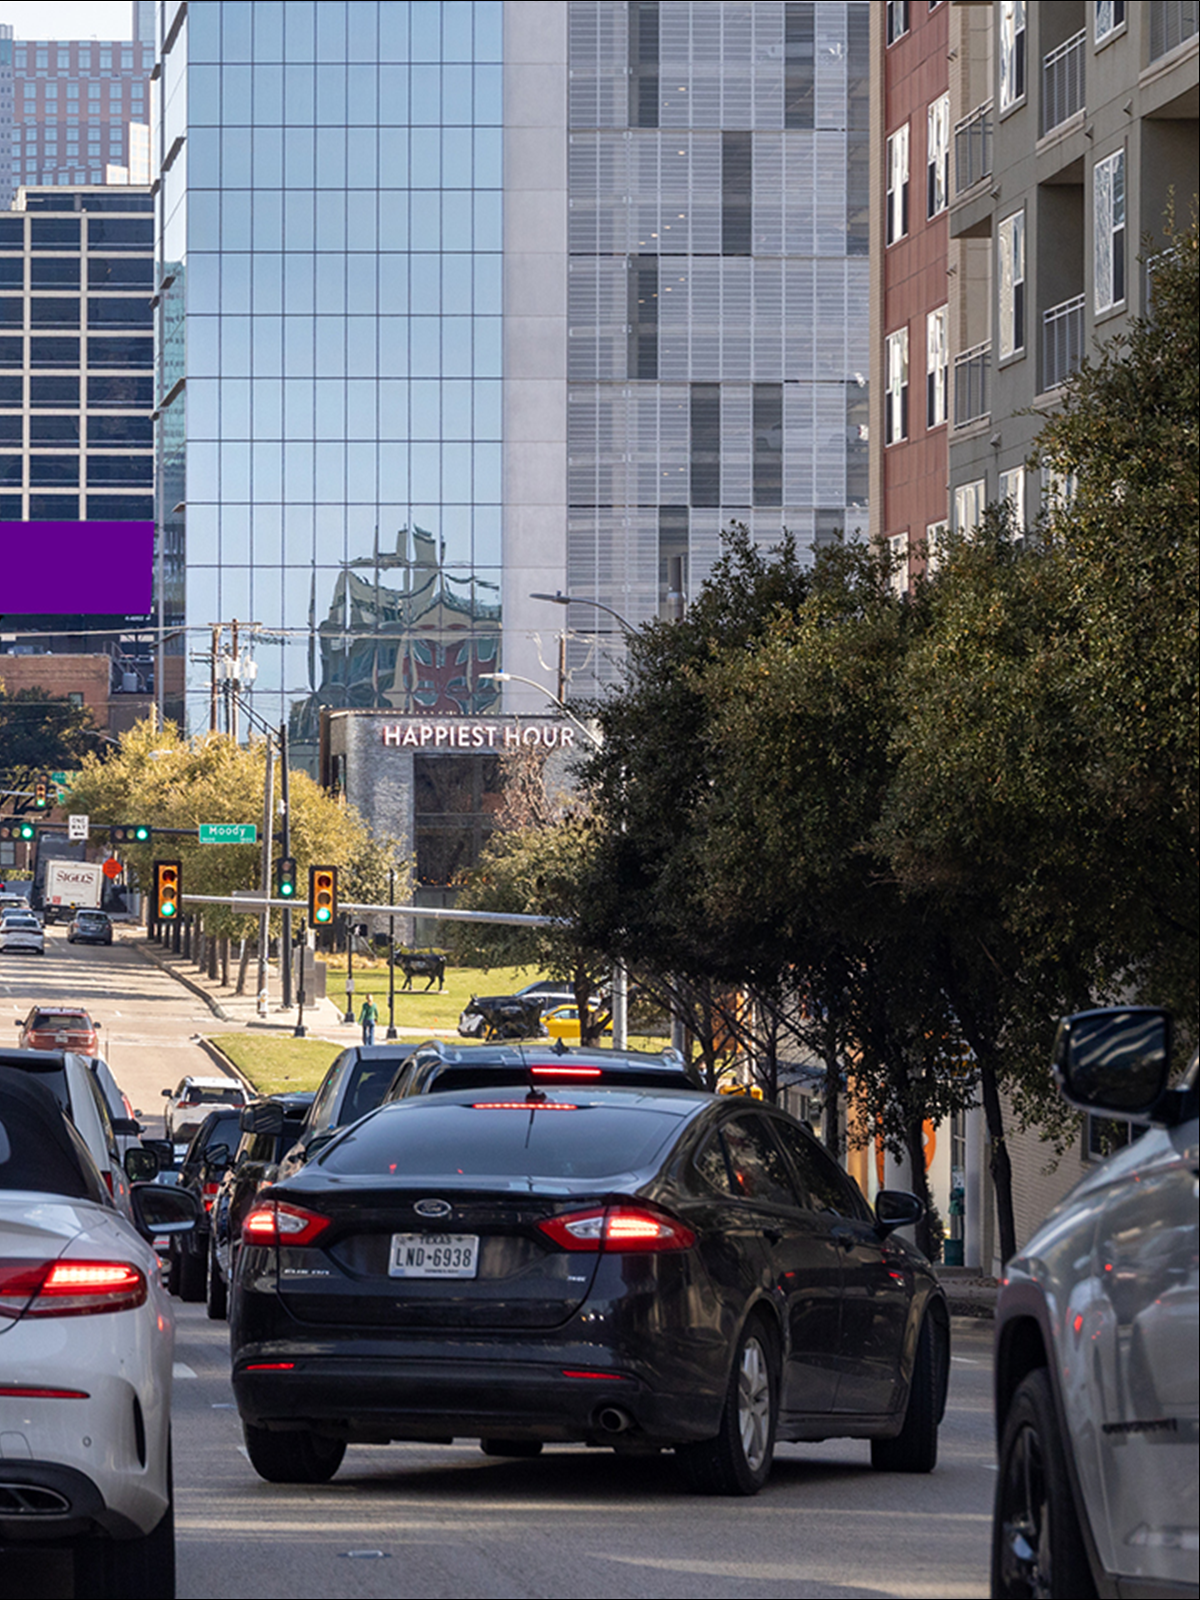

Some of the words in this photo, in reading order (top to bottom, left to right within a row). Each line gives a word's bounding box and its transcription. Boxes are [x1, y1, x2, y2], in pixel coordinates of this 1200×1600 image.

[383, 725, 497, 747] HAPPIEST
[505, 726, 575, 747] HOUR
[209, 825, 246, 838] Moody
[420, 1234, 452, 1245] TEXAS
